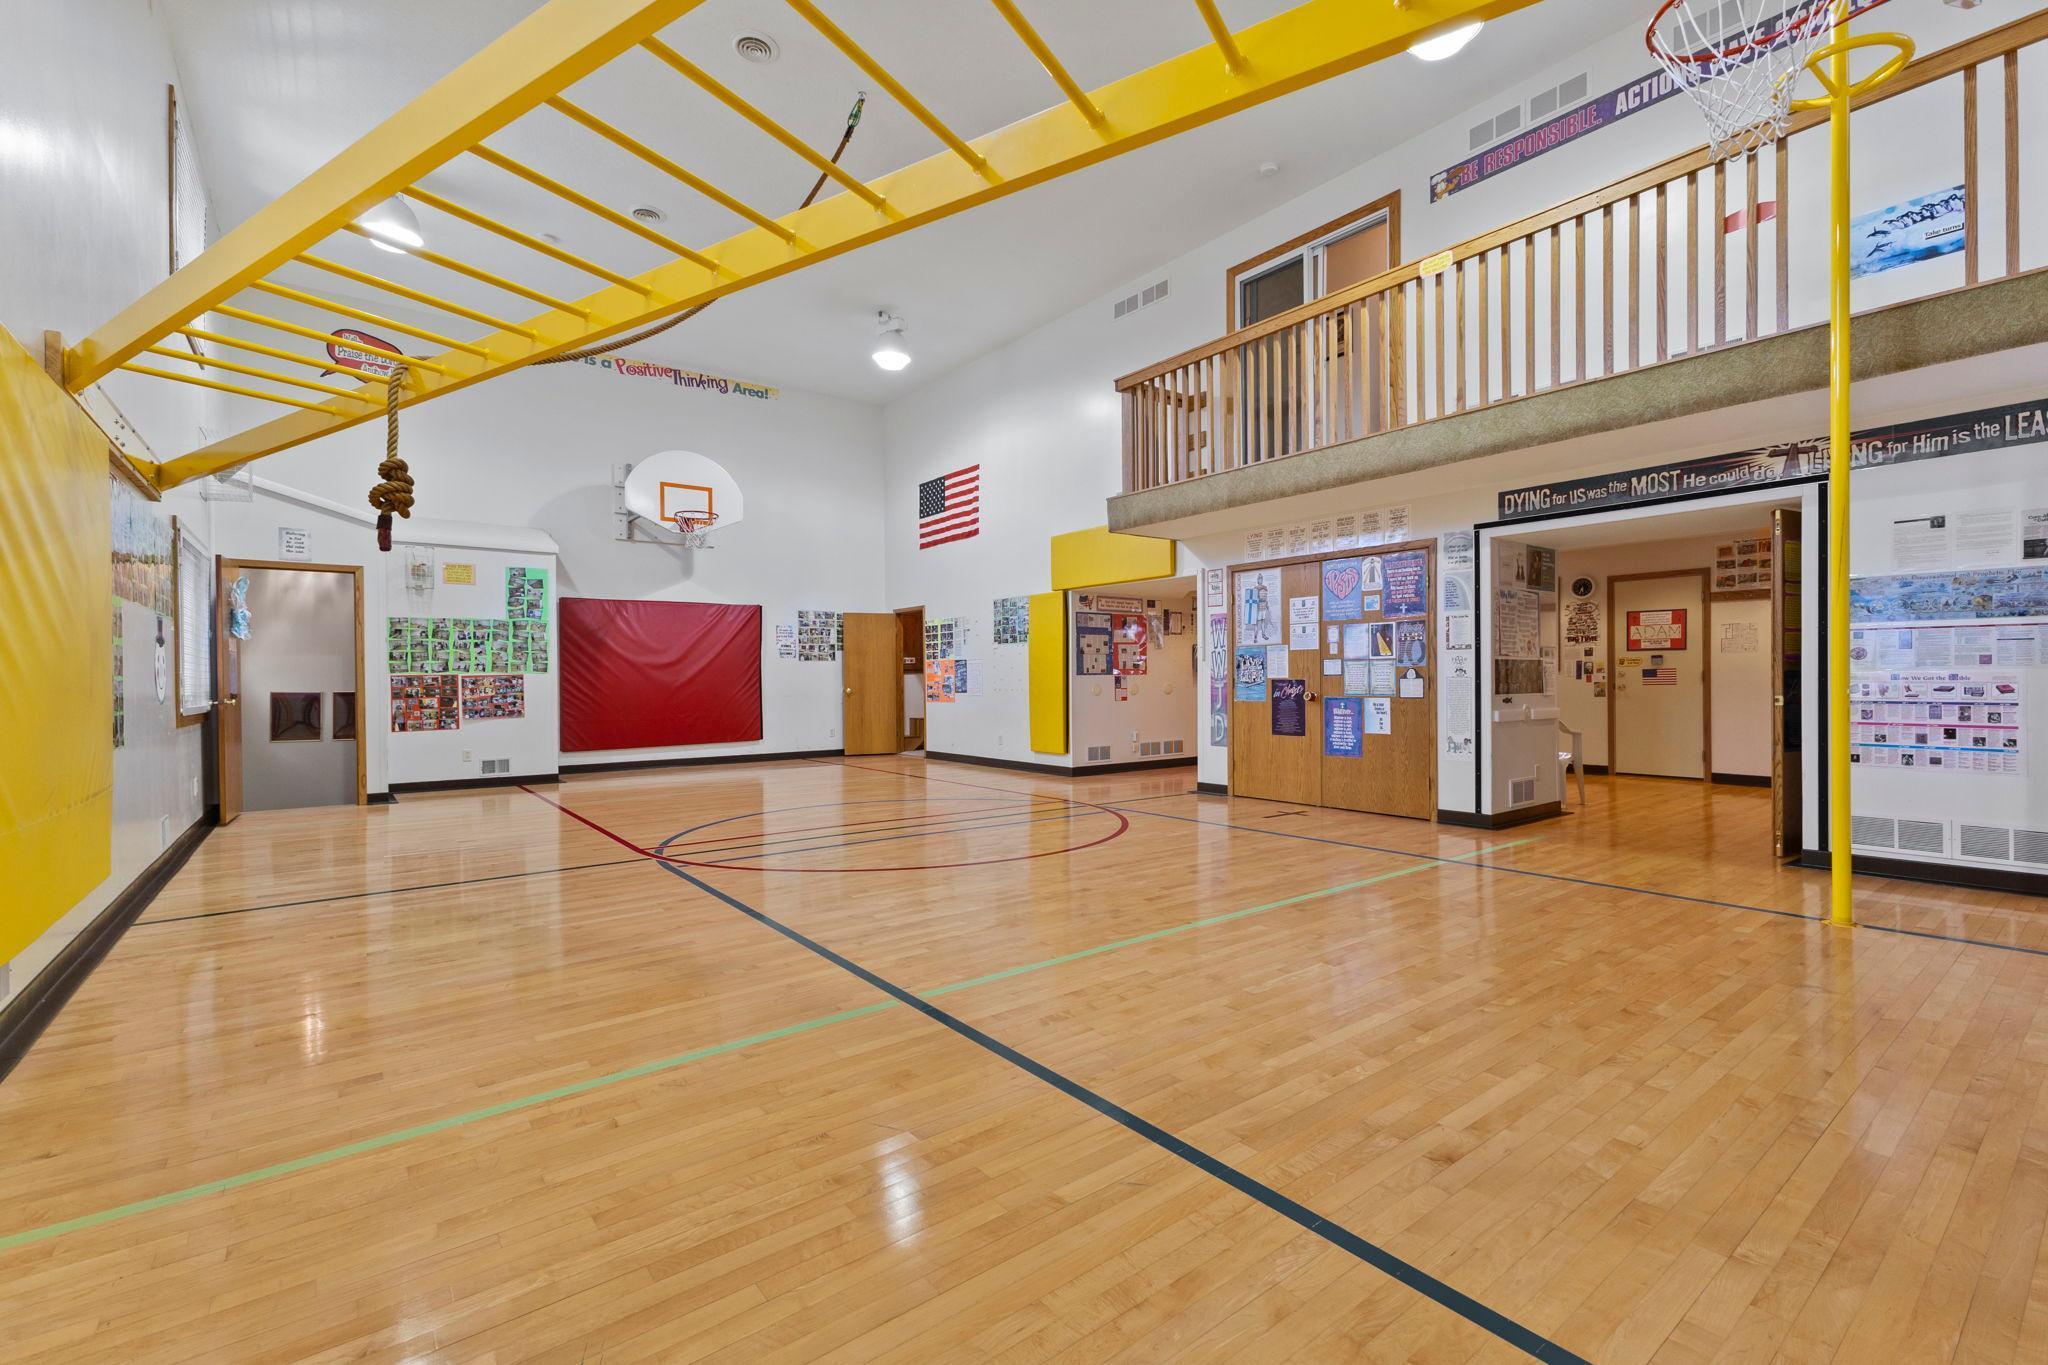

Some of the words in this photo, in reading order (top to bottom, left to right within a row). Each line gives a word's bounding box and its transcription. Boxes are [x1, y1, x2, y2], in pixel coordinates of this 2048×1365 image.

[1460, 160, 1479, 186] BE
[1483, 103, 1603, 175] RESPONSIBLE.
[1924, 228, 1943, 238] Take
[601, 358, 613, 369] a
[615, 358, 673, 379] Positive
[671, 368, 729, 395] Thinking
[732, 382, 769, 400] Area!
[1504, 488, 1551, 515] DYING
[1551, 490, 1567, 505] for
[1586, 487, 1608, 500] was
[1608, 480, 1628, 494] the
[1630, 469, 1682, 497] MOST
[1682, 473, 1707, 489] He
[1708, 464, 1750, 485] could
[1811, 440, 1884, 475] LING
[1886, 441, 1908, 457] for
[1912, 432, 1949, 455] Him
[1952, 429, 1972, 447] is
[1974, 421, 2001, 441] the
[2003, 408, 2048, 442] LEA
[1631, 624, 1682, 640] ADAM
